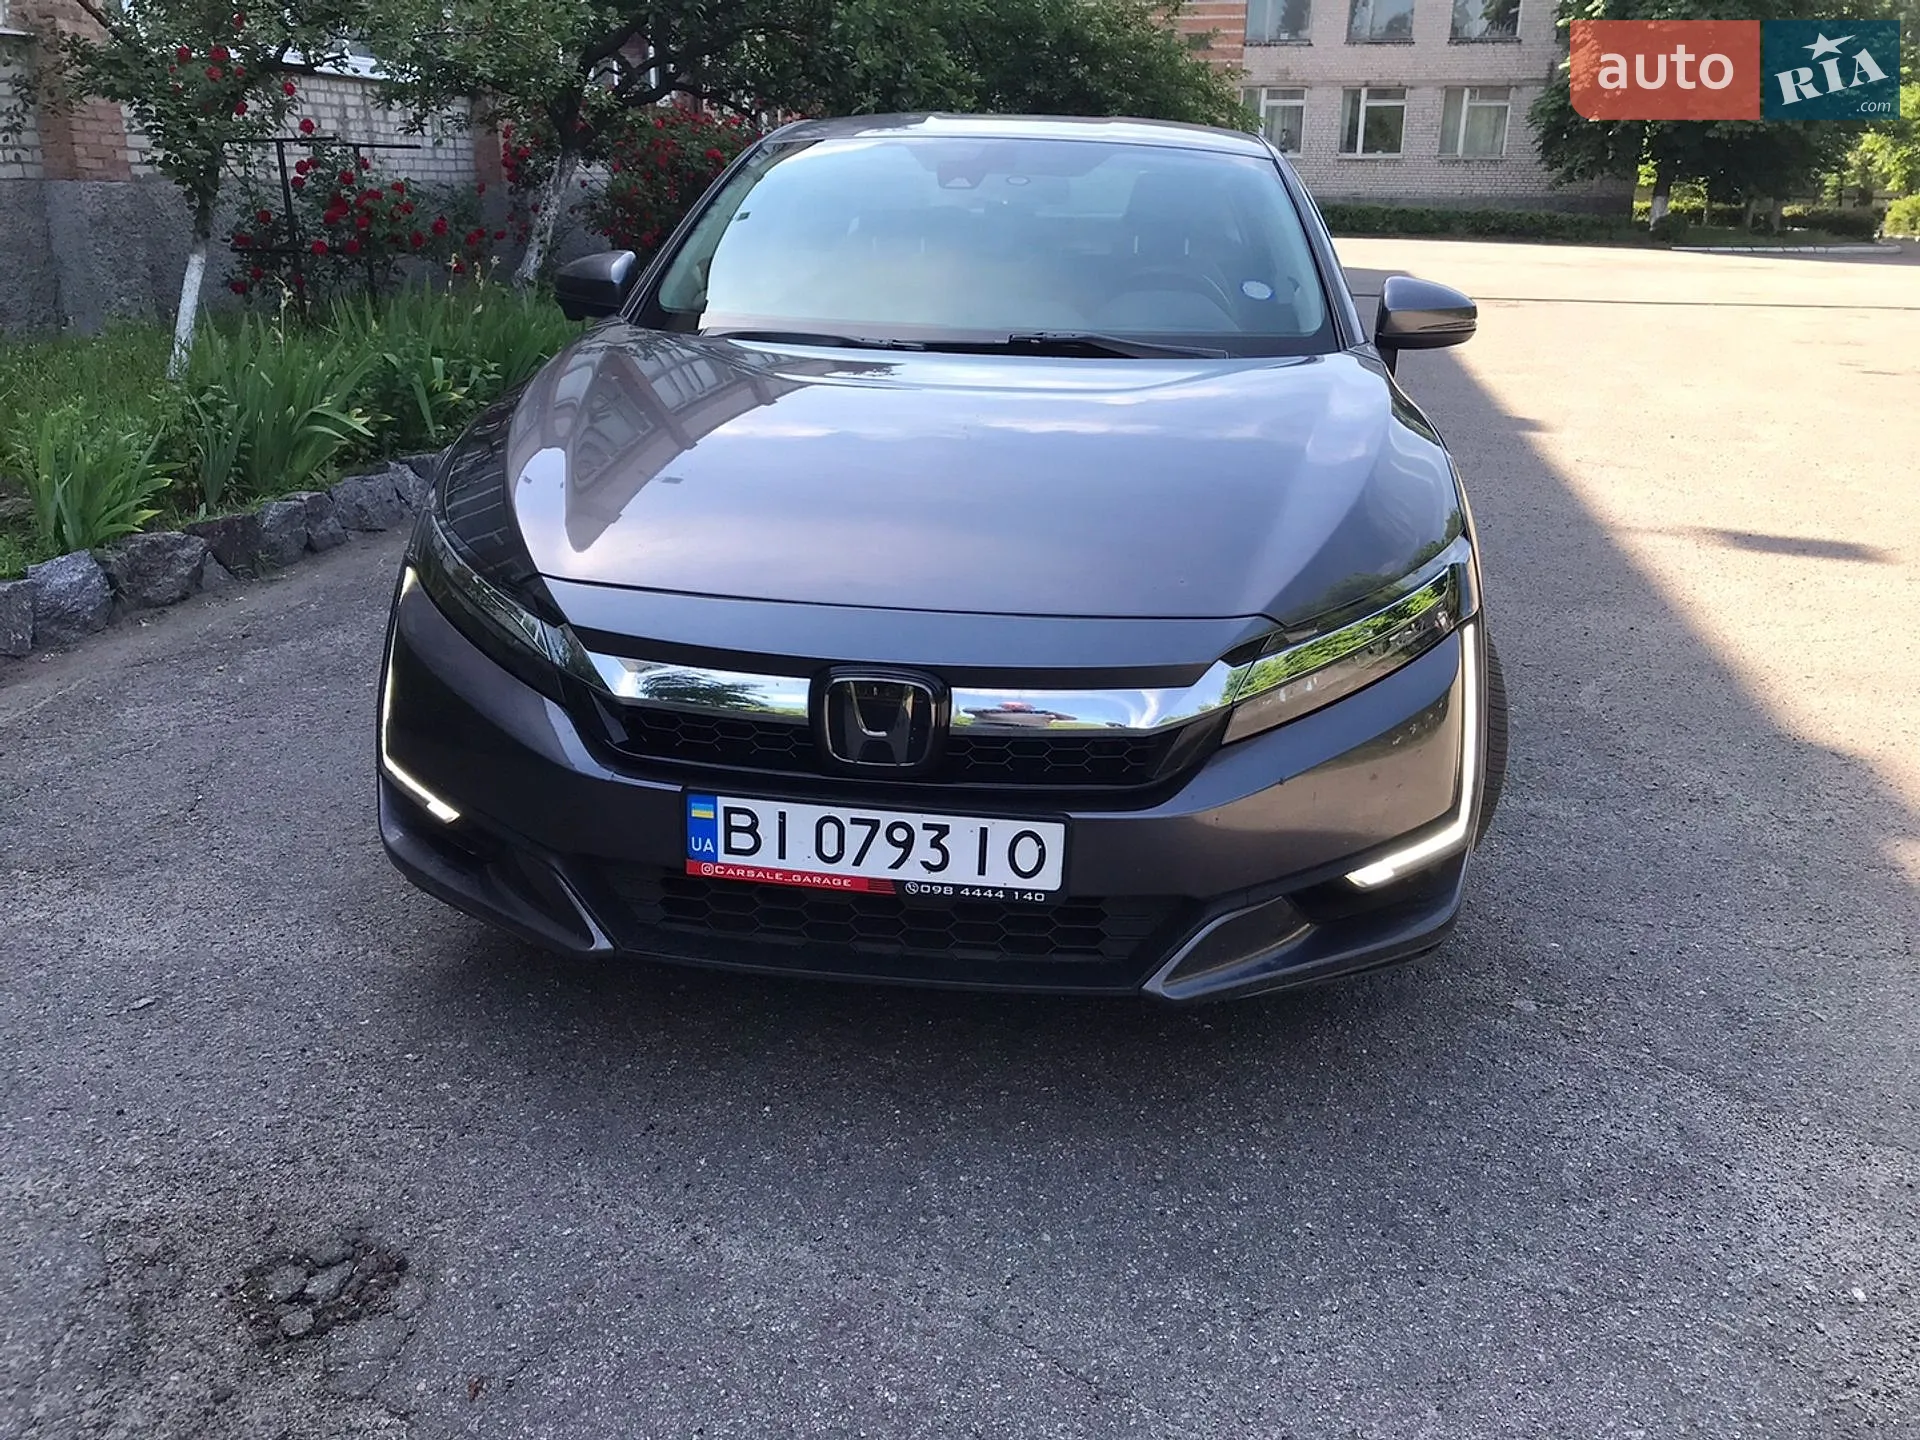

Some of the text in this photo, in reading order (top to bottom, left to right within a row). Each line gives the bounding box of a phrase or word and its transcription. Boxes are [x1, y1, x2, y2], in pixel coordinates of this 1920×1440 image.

[690, 836, 715, 853] UA
[723, 805, 787, 860] BI
[814, 814, 951, 873] 0793
[919, 884, 1046, 902] 098 4444 140
